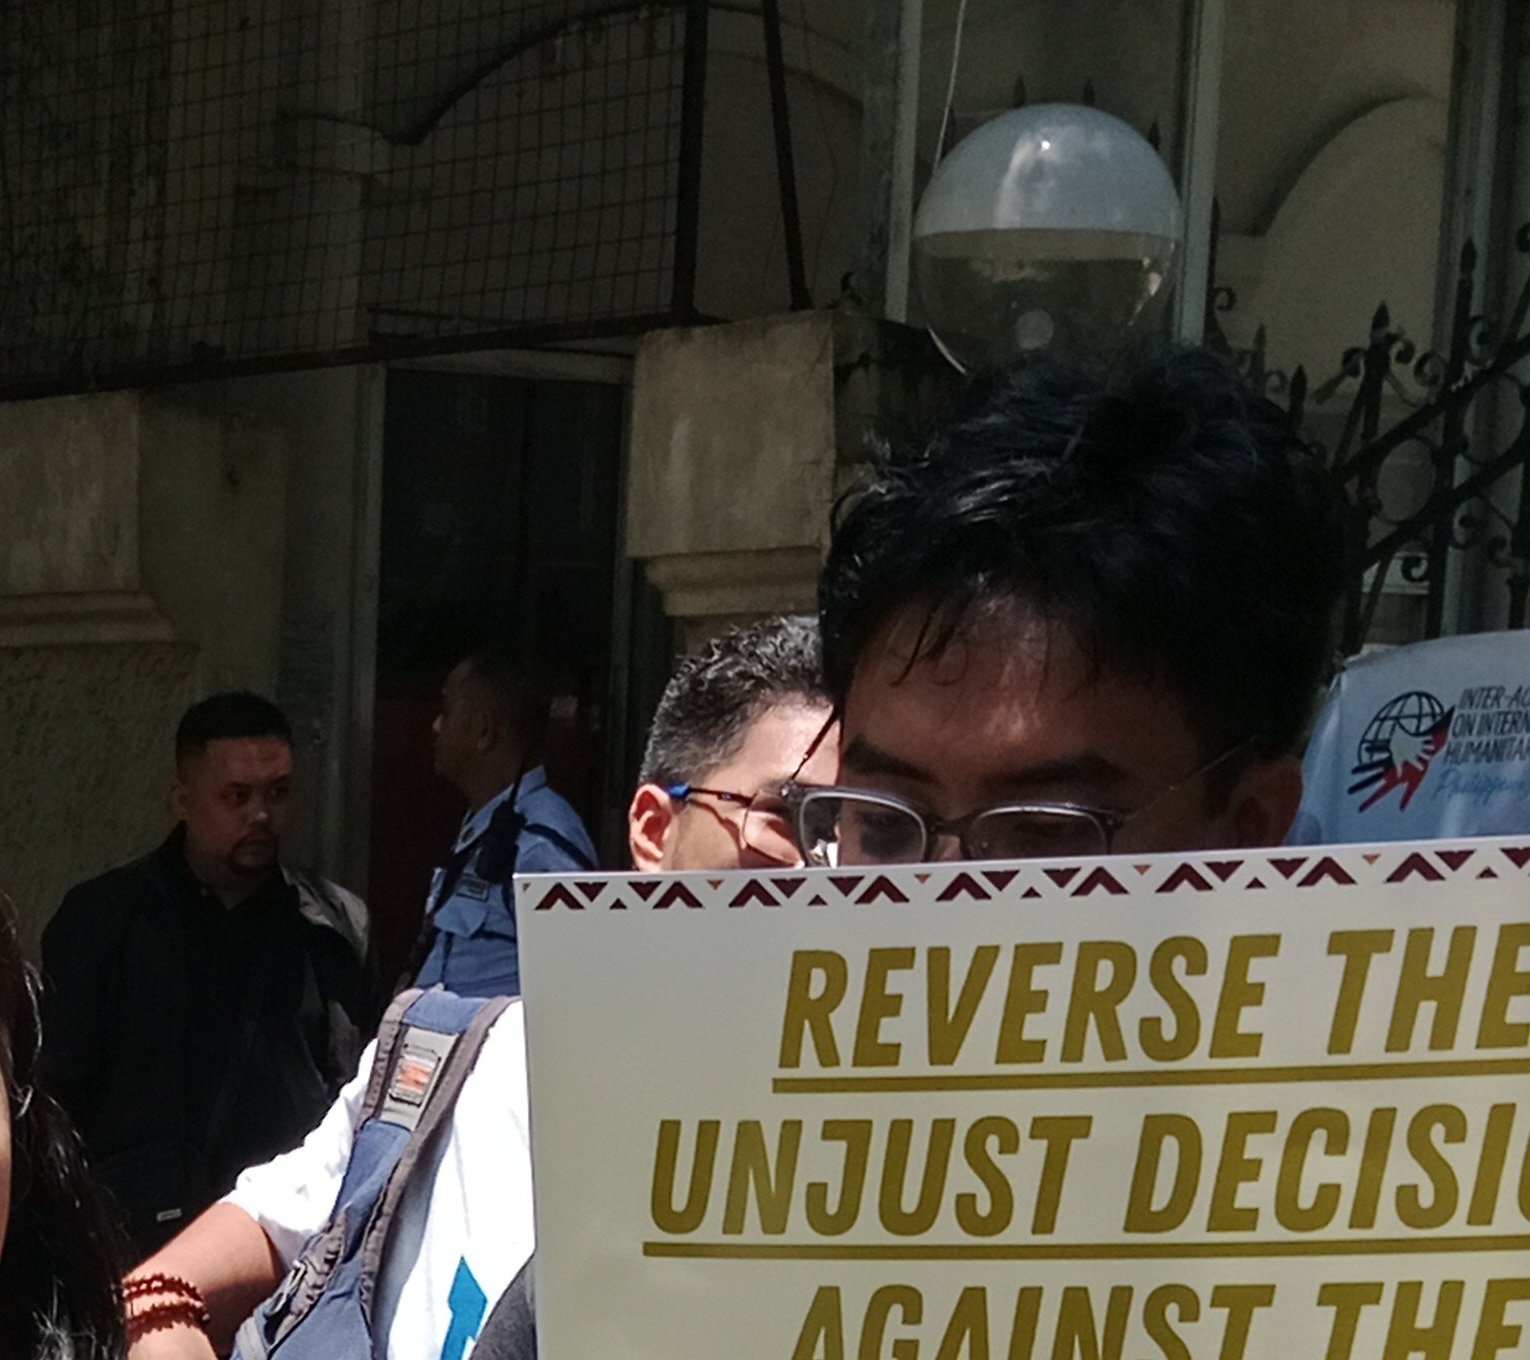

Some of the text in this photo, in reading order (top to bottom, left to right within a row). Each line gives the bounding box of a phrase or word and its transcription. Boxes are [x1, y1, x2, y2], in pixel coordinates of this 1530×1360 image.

[1452, 713, 1479, 739] ON
[778, 922, 1530, 1069] REVERSE THE
[650, 1102, 1530, 1238] UNJUST DECISI
